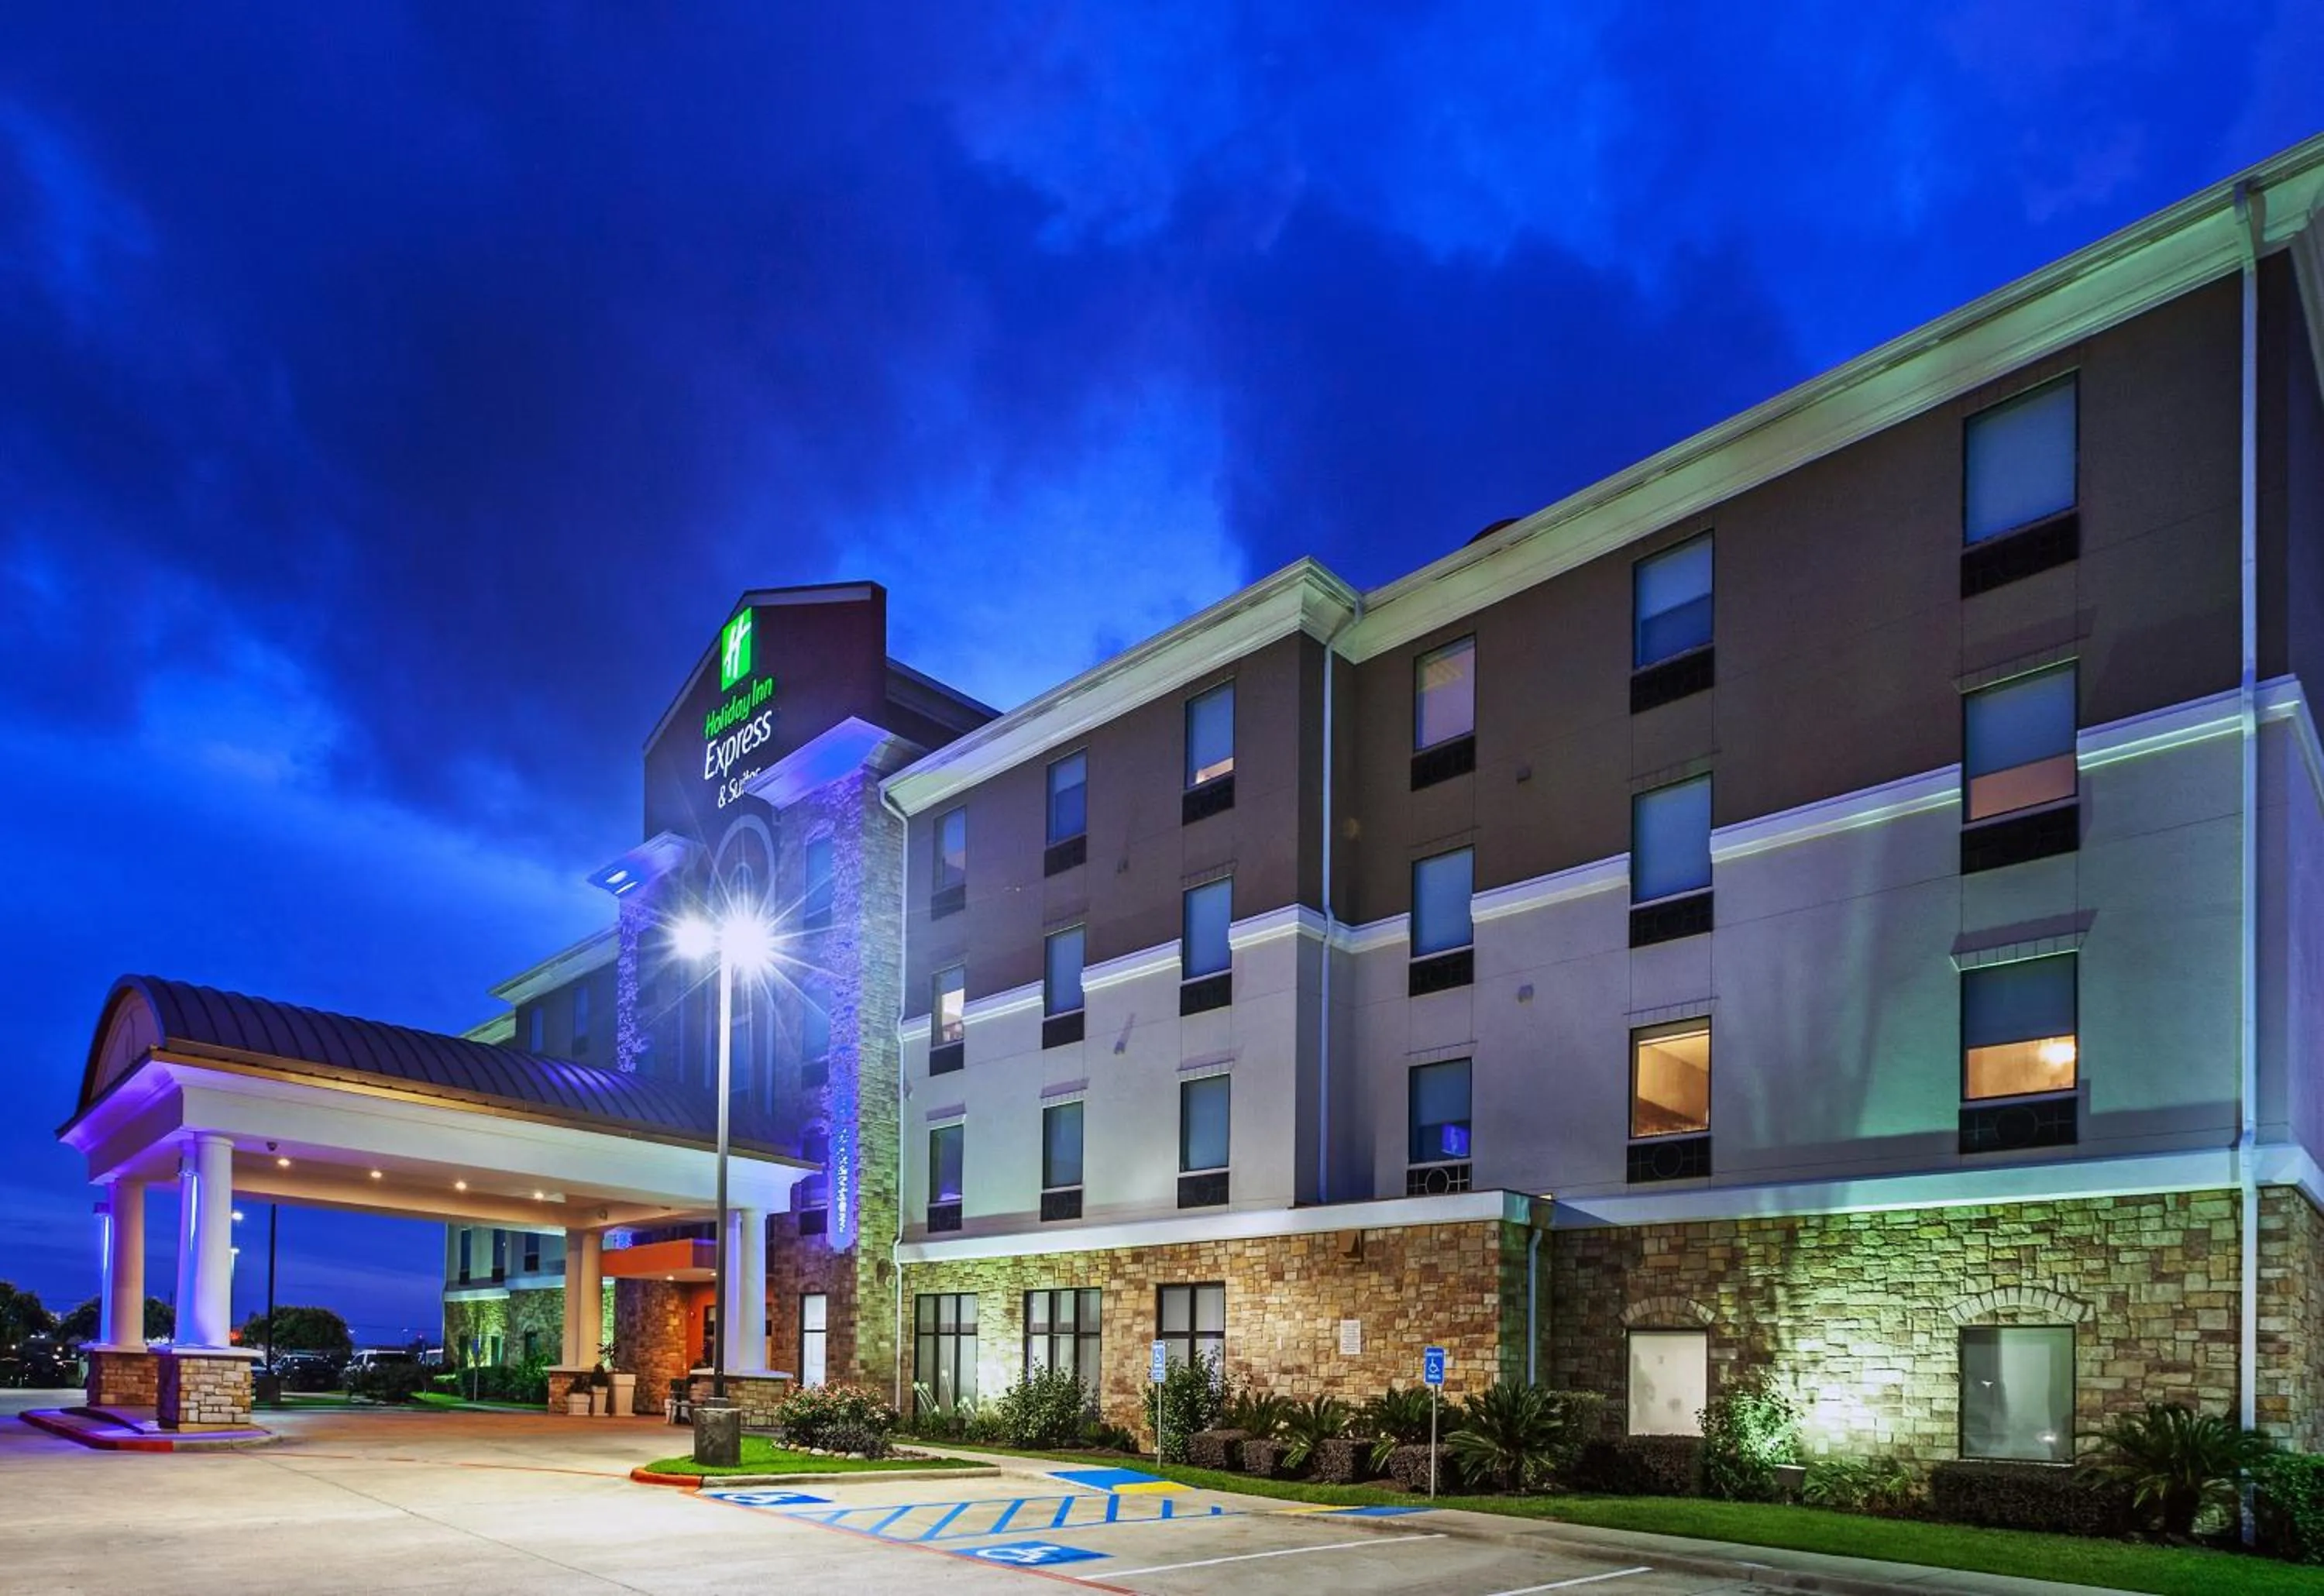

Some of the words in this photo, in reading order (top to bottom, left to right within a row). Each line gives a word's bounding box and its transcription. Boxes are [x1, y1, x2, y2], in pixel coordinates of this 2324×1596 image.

[705, 694, 751, 740] Holiday
[751, 678, 773, 707] Inn
[704, 710, 772, 780] Express
[717, 784, 727, 809] &
